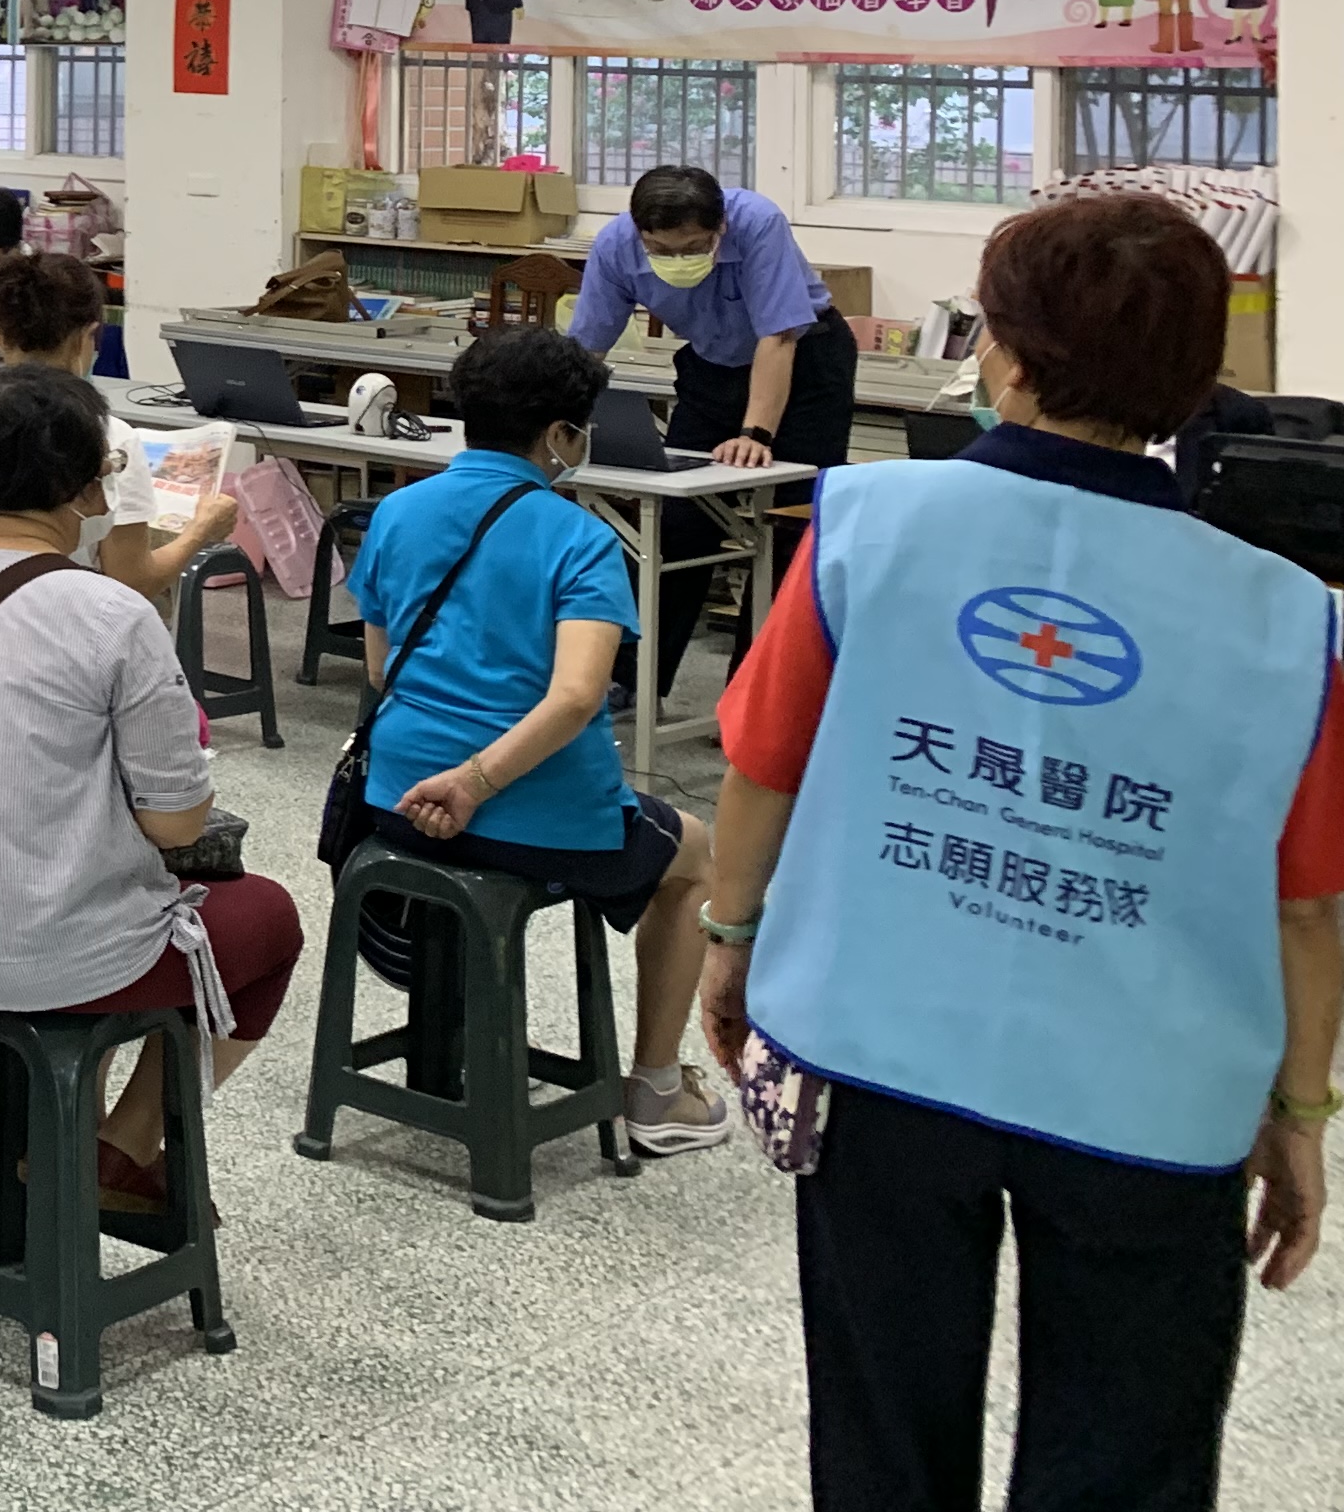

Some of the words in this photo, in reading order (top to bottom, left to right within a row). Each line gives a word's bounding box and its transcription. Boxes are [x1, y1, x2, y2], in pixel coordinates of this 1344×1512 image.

[888, 774, 990, 817] Ten-Chan
[1078, 829, 1166, 863] Hospital
[890, 716, 1175, 833] 天晟醫院
[879, 820, 1151, 929] 志願服務隊
[948, 890, 1086, 947] Volunteer
